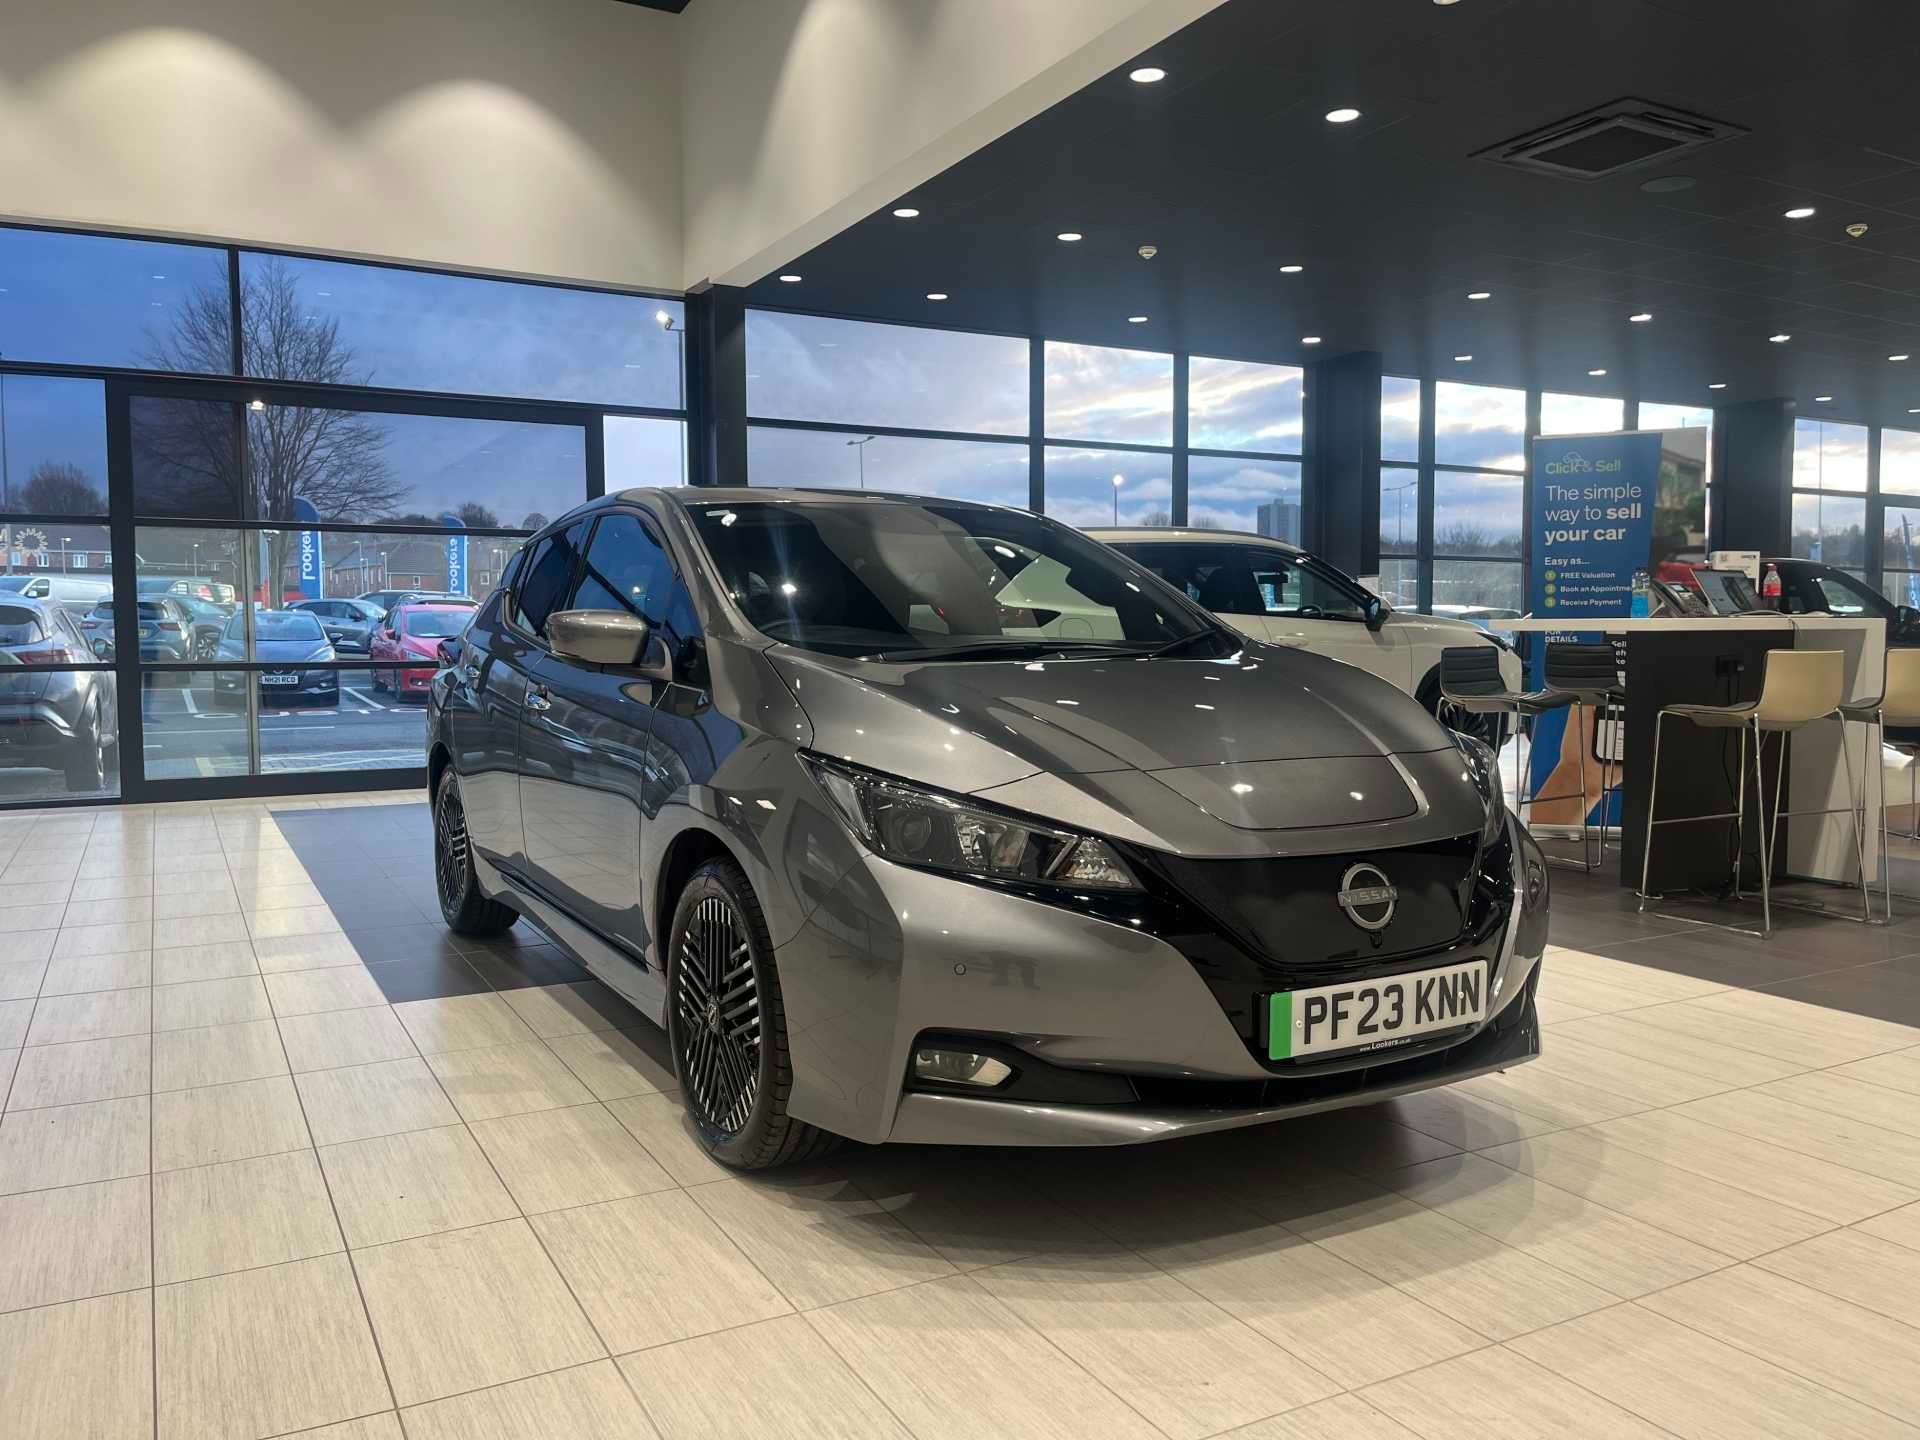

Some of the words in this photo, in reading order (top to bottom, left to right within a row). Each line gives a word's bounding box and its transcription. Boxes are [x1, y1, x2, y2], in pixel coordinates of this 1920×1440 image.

[1545, 460, 1582, 474] Click
[1595, 459, 1622, 472] Sell
[1545, 485, 1580, 501] The
[1583, 482, 1642, 503] simple
[1545, 508, 1580, 525] way
[1584, 504, 1602, 520] to
[1606, 503, 1642, 519] sell
[1544, 528, 1590, 546] your
[1593, 527, 1627, 541] car
[1544, 556, 1569, 567] Easy
[1560, 571, 1581, 579] FREE
[1582, 571, 1616, 579] Valuation
[1560, 585, 1578, 593] Book
[1590, 585, 1632, 595] Appointme
[1589, 598, 1623, 607] Payment
[1544, 635, 1579, 644] DETAILS
[1341, 887, 1397, 906] NISSAN
[1304, 983, 1404, 1045] PF23
[1415, 969, 1480, 1025] KNN
